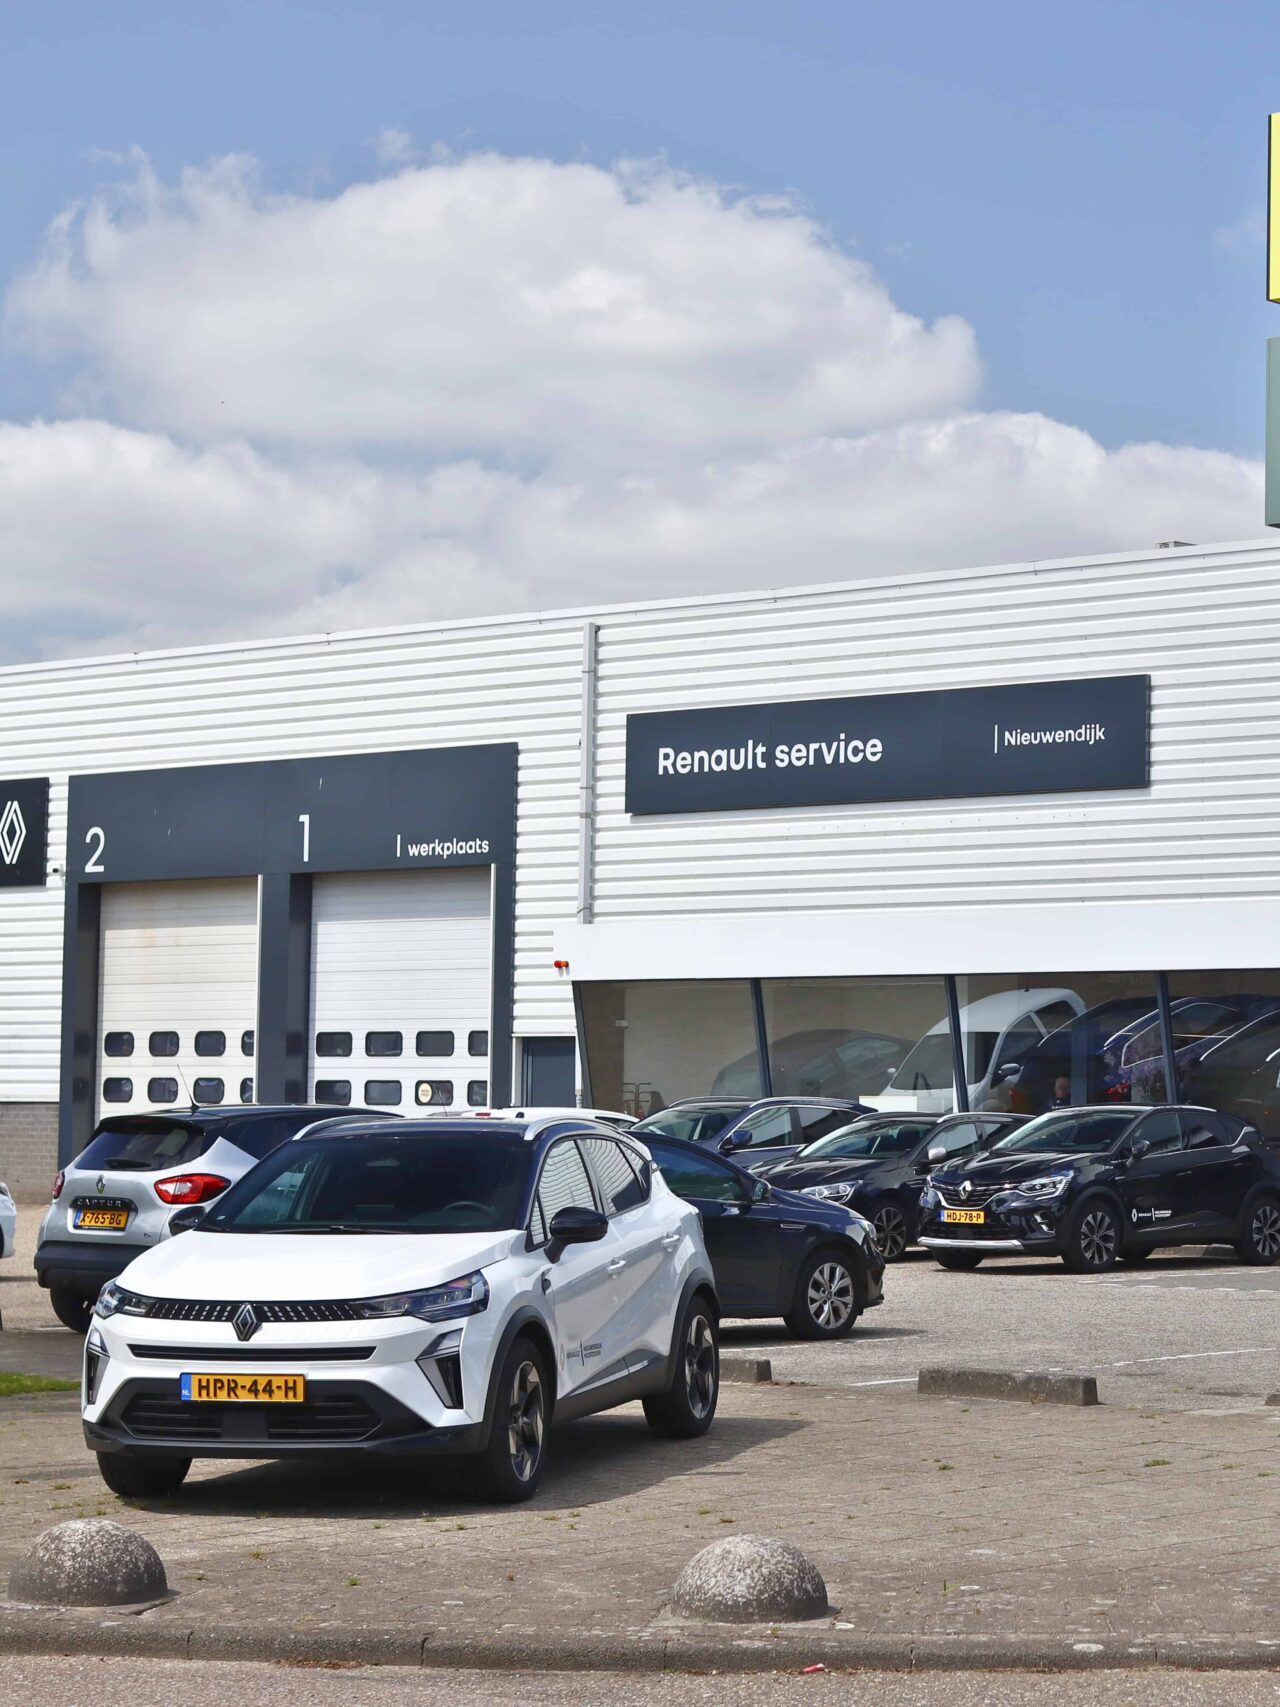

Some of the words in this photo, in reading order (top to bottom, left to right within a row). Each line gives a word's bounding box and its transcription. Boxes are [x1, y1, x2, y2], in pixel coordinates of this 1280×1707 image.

[1004, 724, 1106, 747] Nieuwendijk
[657, 738, 767, 775] Renault
[774, 733, 883, 768] service
[84, 826, 105, 873] 2
[299, 814, 310, 862] 1
[408, 837, 490, 860] werkplaats
[80, 1210, 122, 1226] X-765-BG
[946, 1211, 982, 1222] HDJ-78-P
[198, 1378, 298, 1399] HPR-44-H
